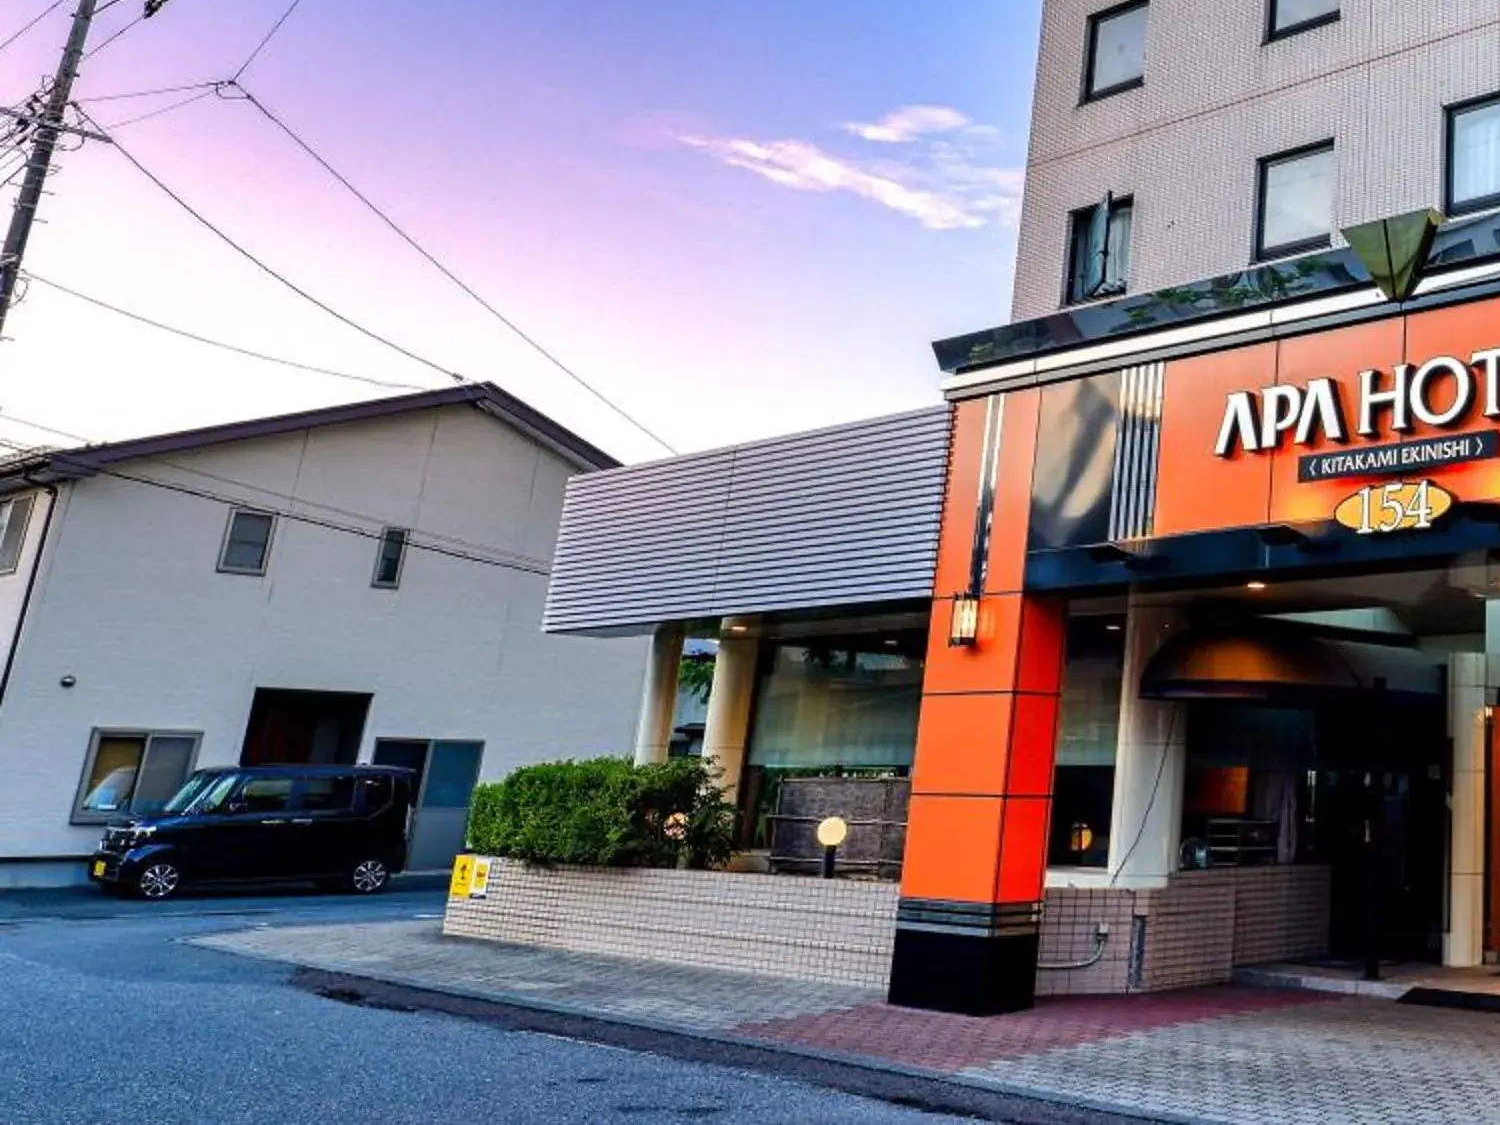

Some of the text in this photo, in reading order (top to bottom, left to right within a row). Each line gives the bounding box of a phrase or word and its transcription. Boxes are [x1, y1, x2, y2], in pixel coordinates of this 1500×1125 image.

[1214, 377, 1344, 456] APA
[1320, 438, 1470, 475] KITAKAMI EKINISHI
[1356, 479, 1432, 535] 154
